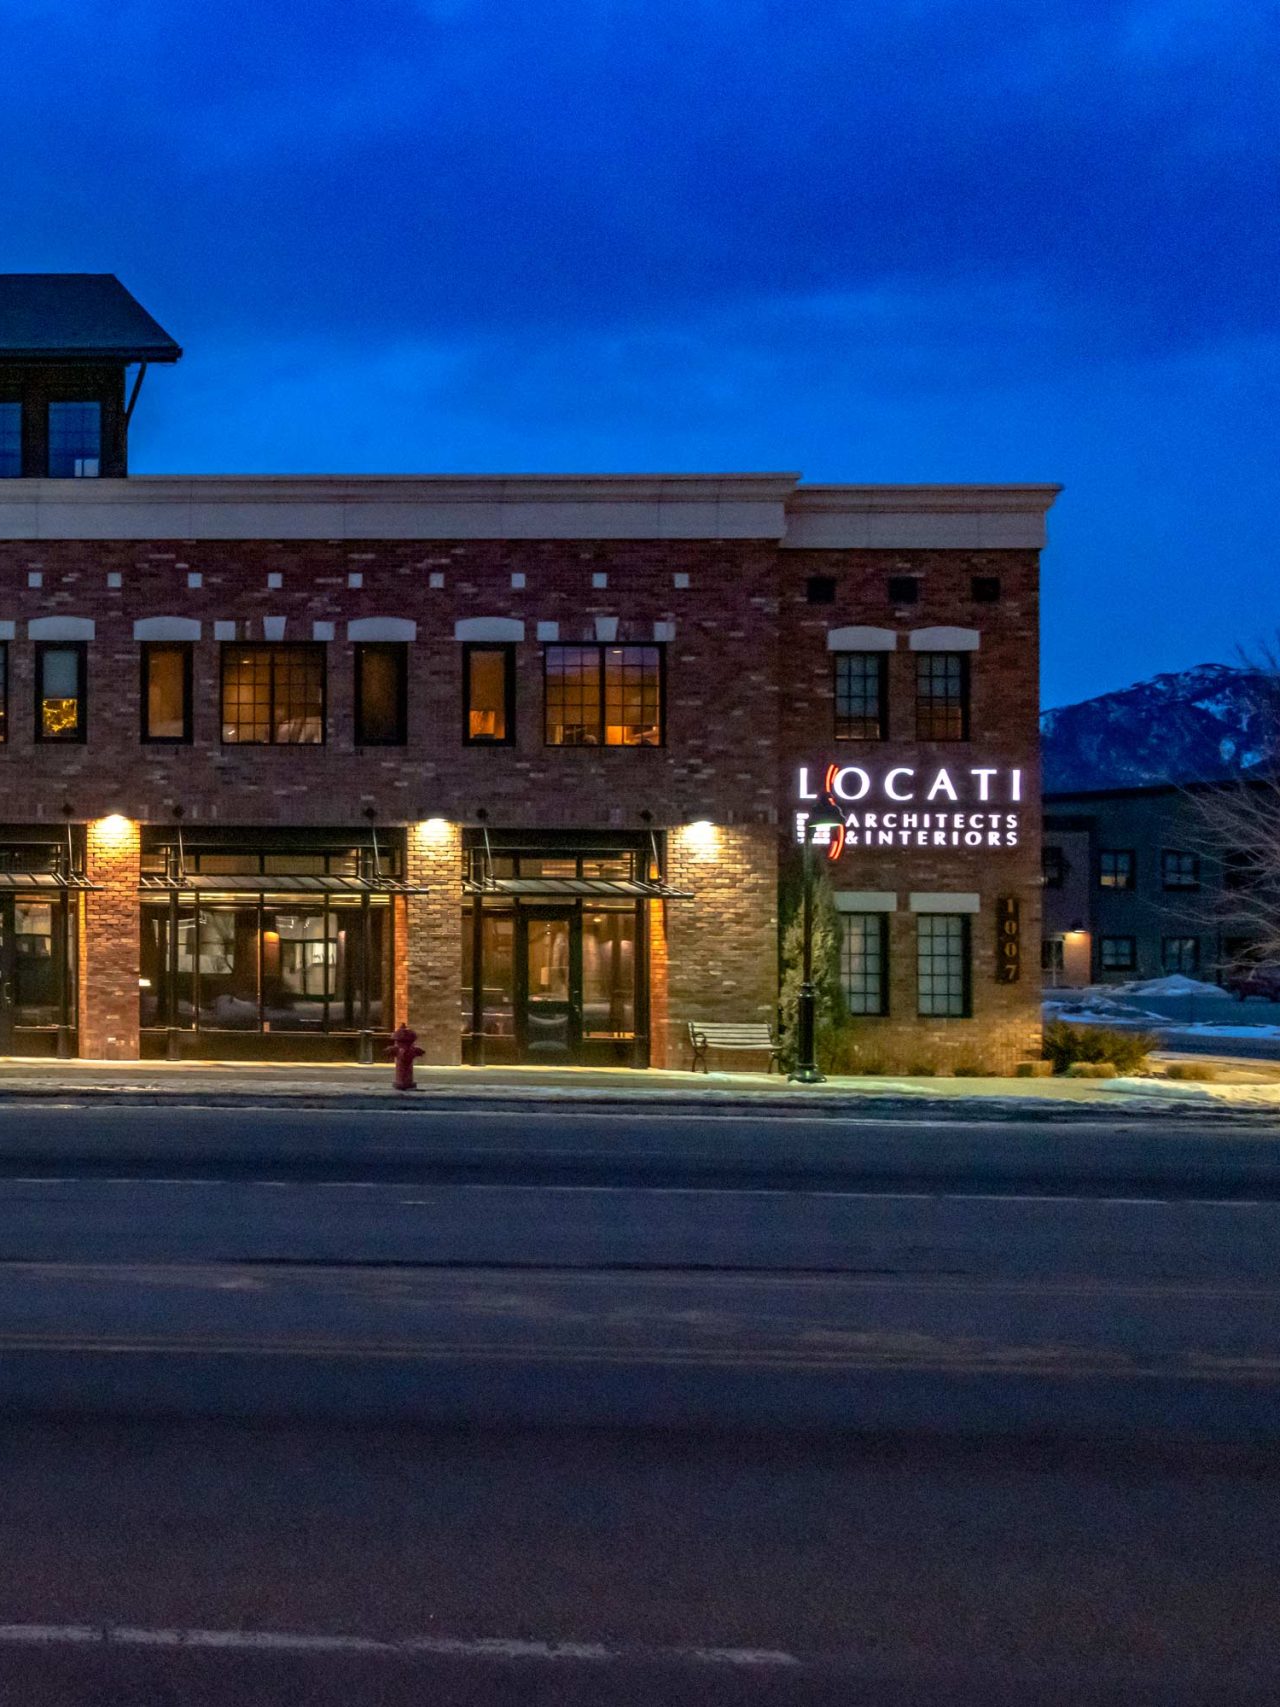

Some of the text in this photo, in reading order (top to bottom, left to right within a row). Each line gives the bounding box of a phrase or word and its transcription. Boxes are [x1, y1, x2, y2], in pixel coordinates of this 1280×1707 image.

[799, 766, 1022, 801] LOCATI
[845, 812, 1019, 829] ARCHITECTS
[1003, 897, 1018, 981] 1007
